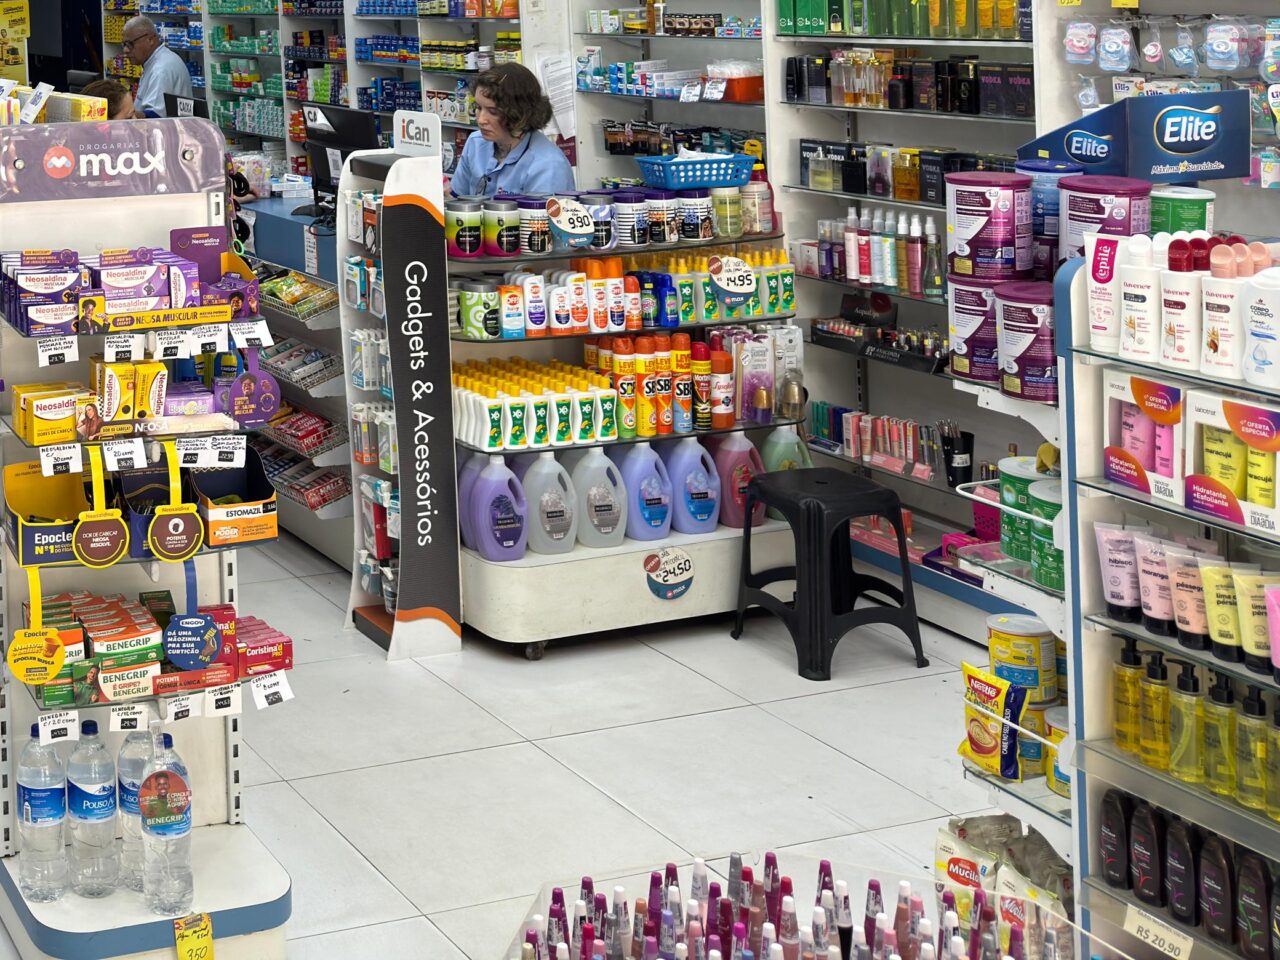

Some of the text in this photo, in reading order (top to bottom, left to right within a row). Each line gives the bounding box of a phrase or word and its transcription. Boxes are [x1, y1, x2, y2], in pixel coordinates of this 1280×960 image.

[180, 102, 192, 112] CAIXA
[402, 118, 430, 142] iCan
[1164, 116, 1216, 143] Elite
[79, 142, 140, 151] DROGARIAS
[1071, 137, 1108, 157] Elite
[80, 150, 165, 176] max
[1151, 162, 1221, 174] Máxima Suavidade
[1096, 244, 1111, 279] epilê
[25, 275, 68, 283] Neosaldina
[106, 269, 147, 278] Neosaldina
[108, 300, 149, 309] Neosaldina
[162, 312, 198, 322] MUSCULAR
[105, 374, 113, 418] Neosaldina
[156, 373, 165, 416] Neosaldina
[35, 399, 76, 412] Neosaldin
[402, 261, 438, 547] Gadgets & Acessórios
[1145, 402, 1168, 411] ESPECIAL
[134, 422, 168, 433] NEOSA
[1247, 421, 1270, 431] OFERTA
[1242, 427, 1269, 438] ESPECIAL
[1205, 448, 1231, 459] maracujá
[1193, 485, 1226, 499] Hidratante
[226, 508, 262, 518] ESTOMAZIL
[35, 532, 72, 544] Epocle
[1109, 558, 1133, 566] hibisco
[663, 559, 691, 582] 24,50
[106, 637, 150, 652] BENEGRIP
[103, 670, 149, 683] BENEGRIP
[156, 675, 180, 683] POTENTE
[113, 681, 141, 690] É GRIPE?
[970, 679, 997, 698] Nestlé
[113, 687, 149, 697] BENEGRIP
[147, 815, 183, 825] BENEGRIP
[949, 863, 980, 882] Mucilo
[1136, 924, 1150, 940] R$
[1151, 935, 1181, 957] 20,90
